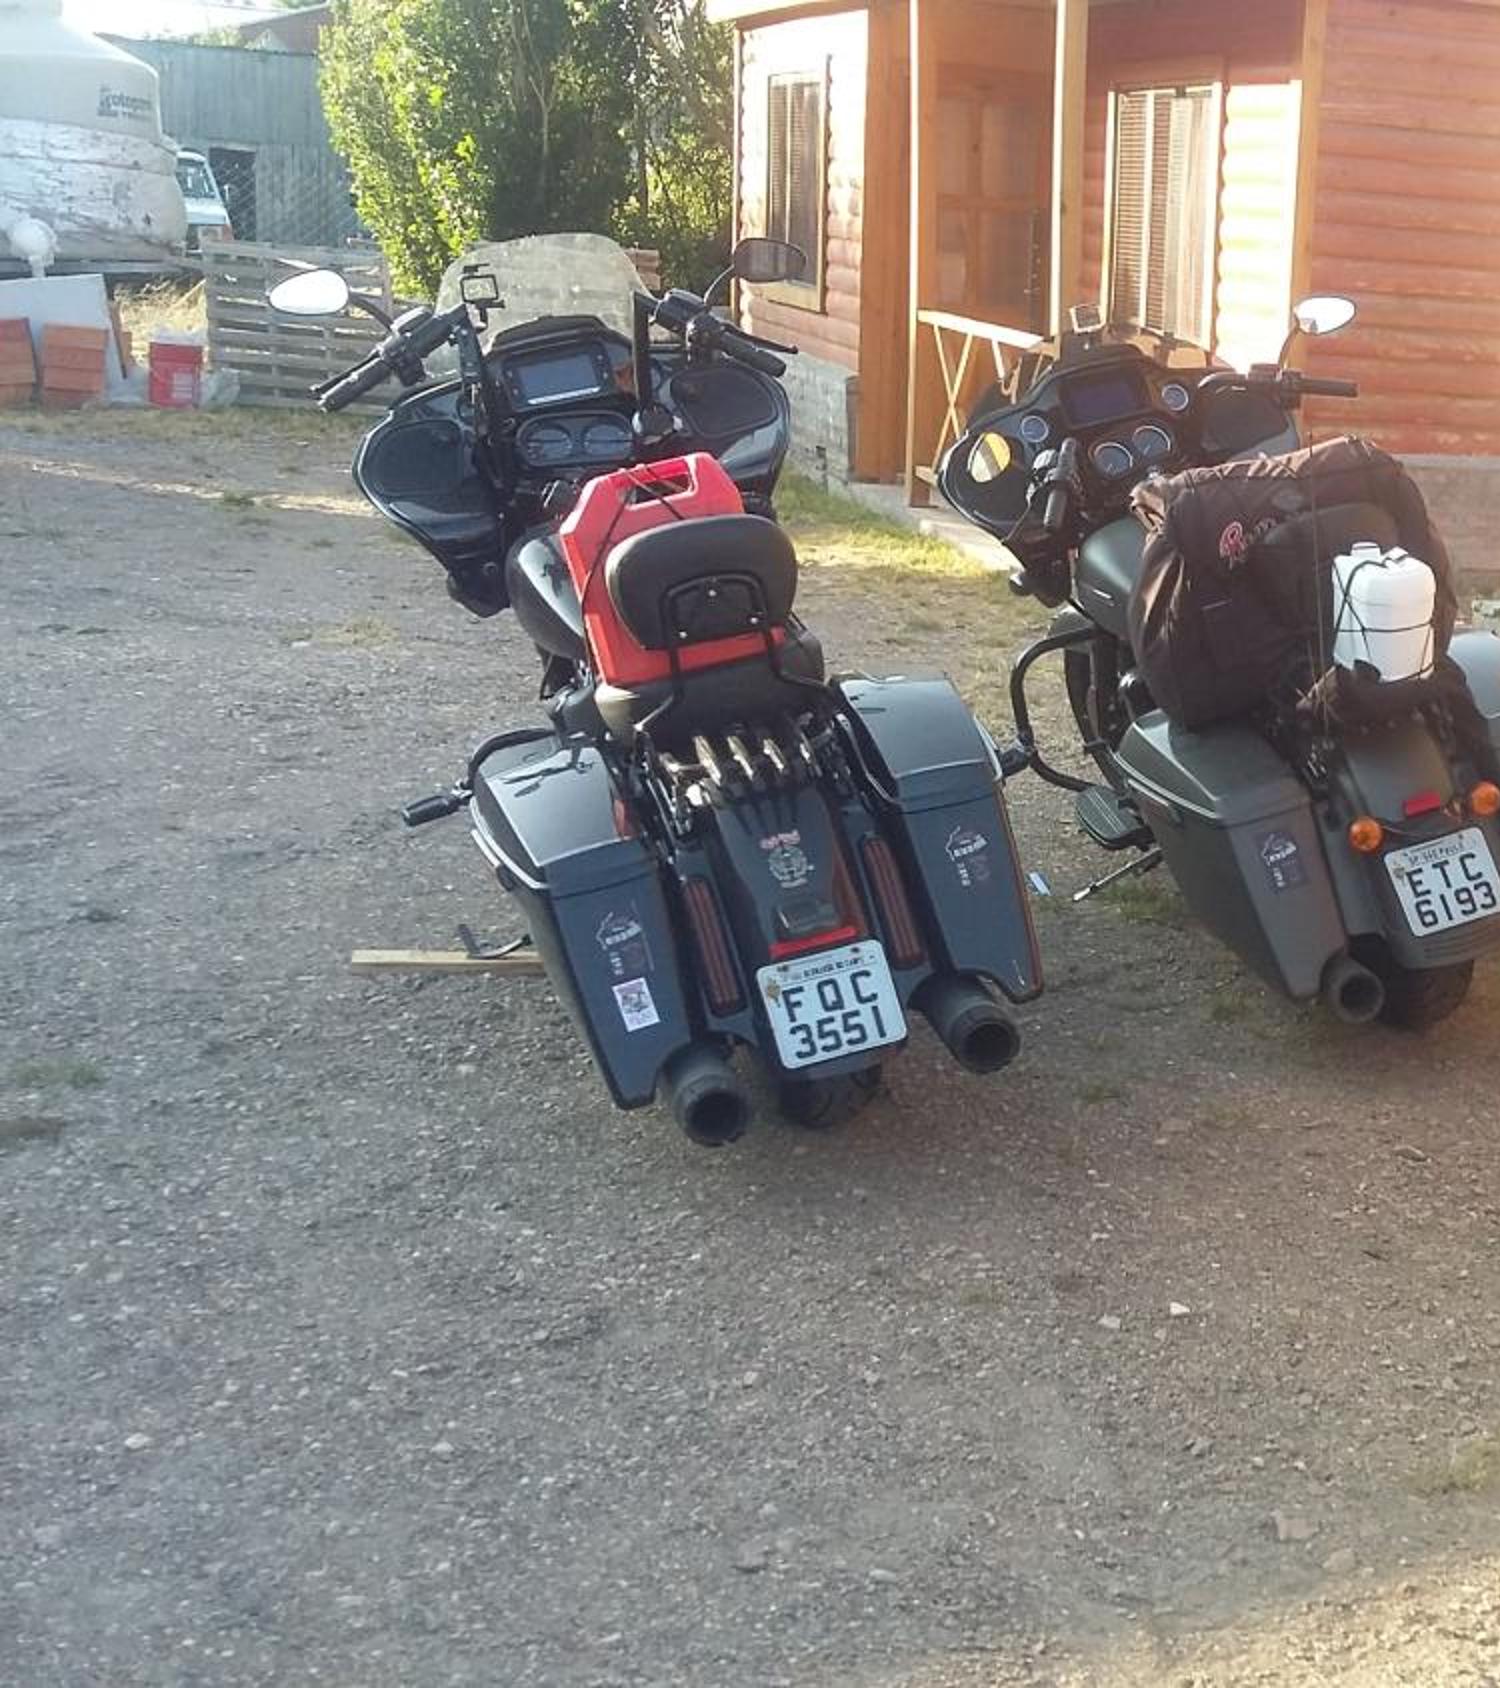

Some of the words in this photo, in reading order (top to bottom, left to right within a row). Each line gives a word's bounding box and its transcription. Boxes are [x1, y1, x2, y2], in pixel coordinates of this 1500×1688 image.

[1405, 852, 1483, 898] ETC
[1415, 881, 1497, 928] 6193
[781, 969, 878, 1023] FQC
[789, 1005, 887, 1059] 3551
